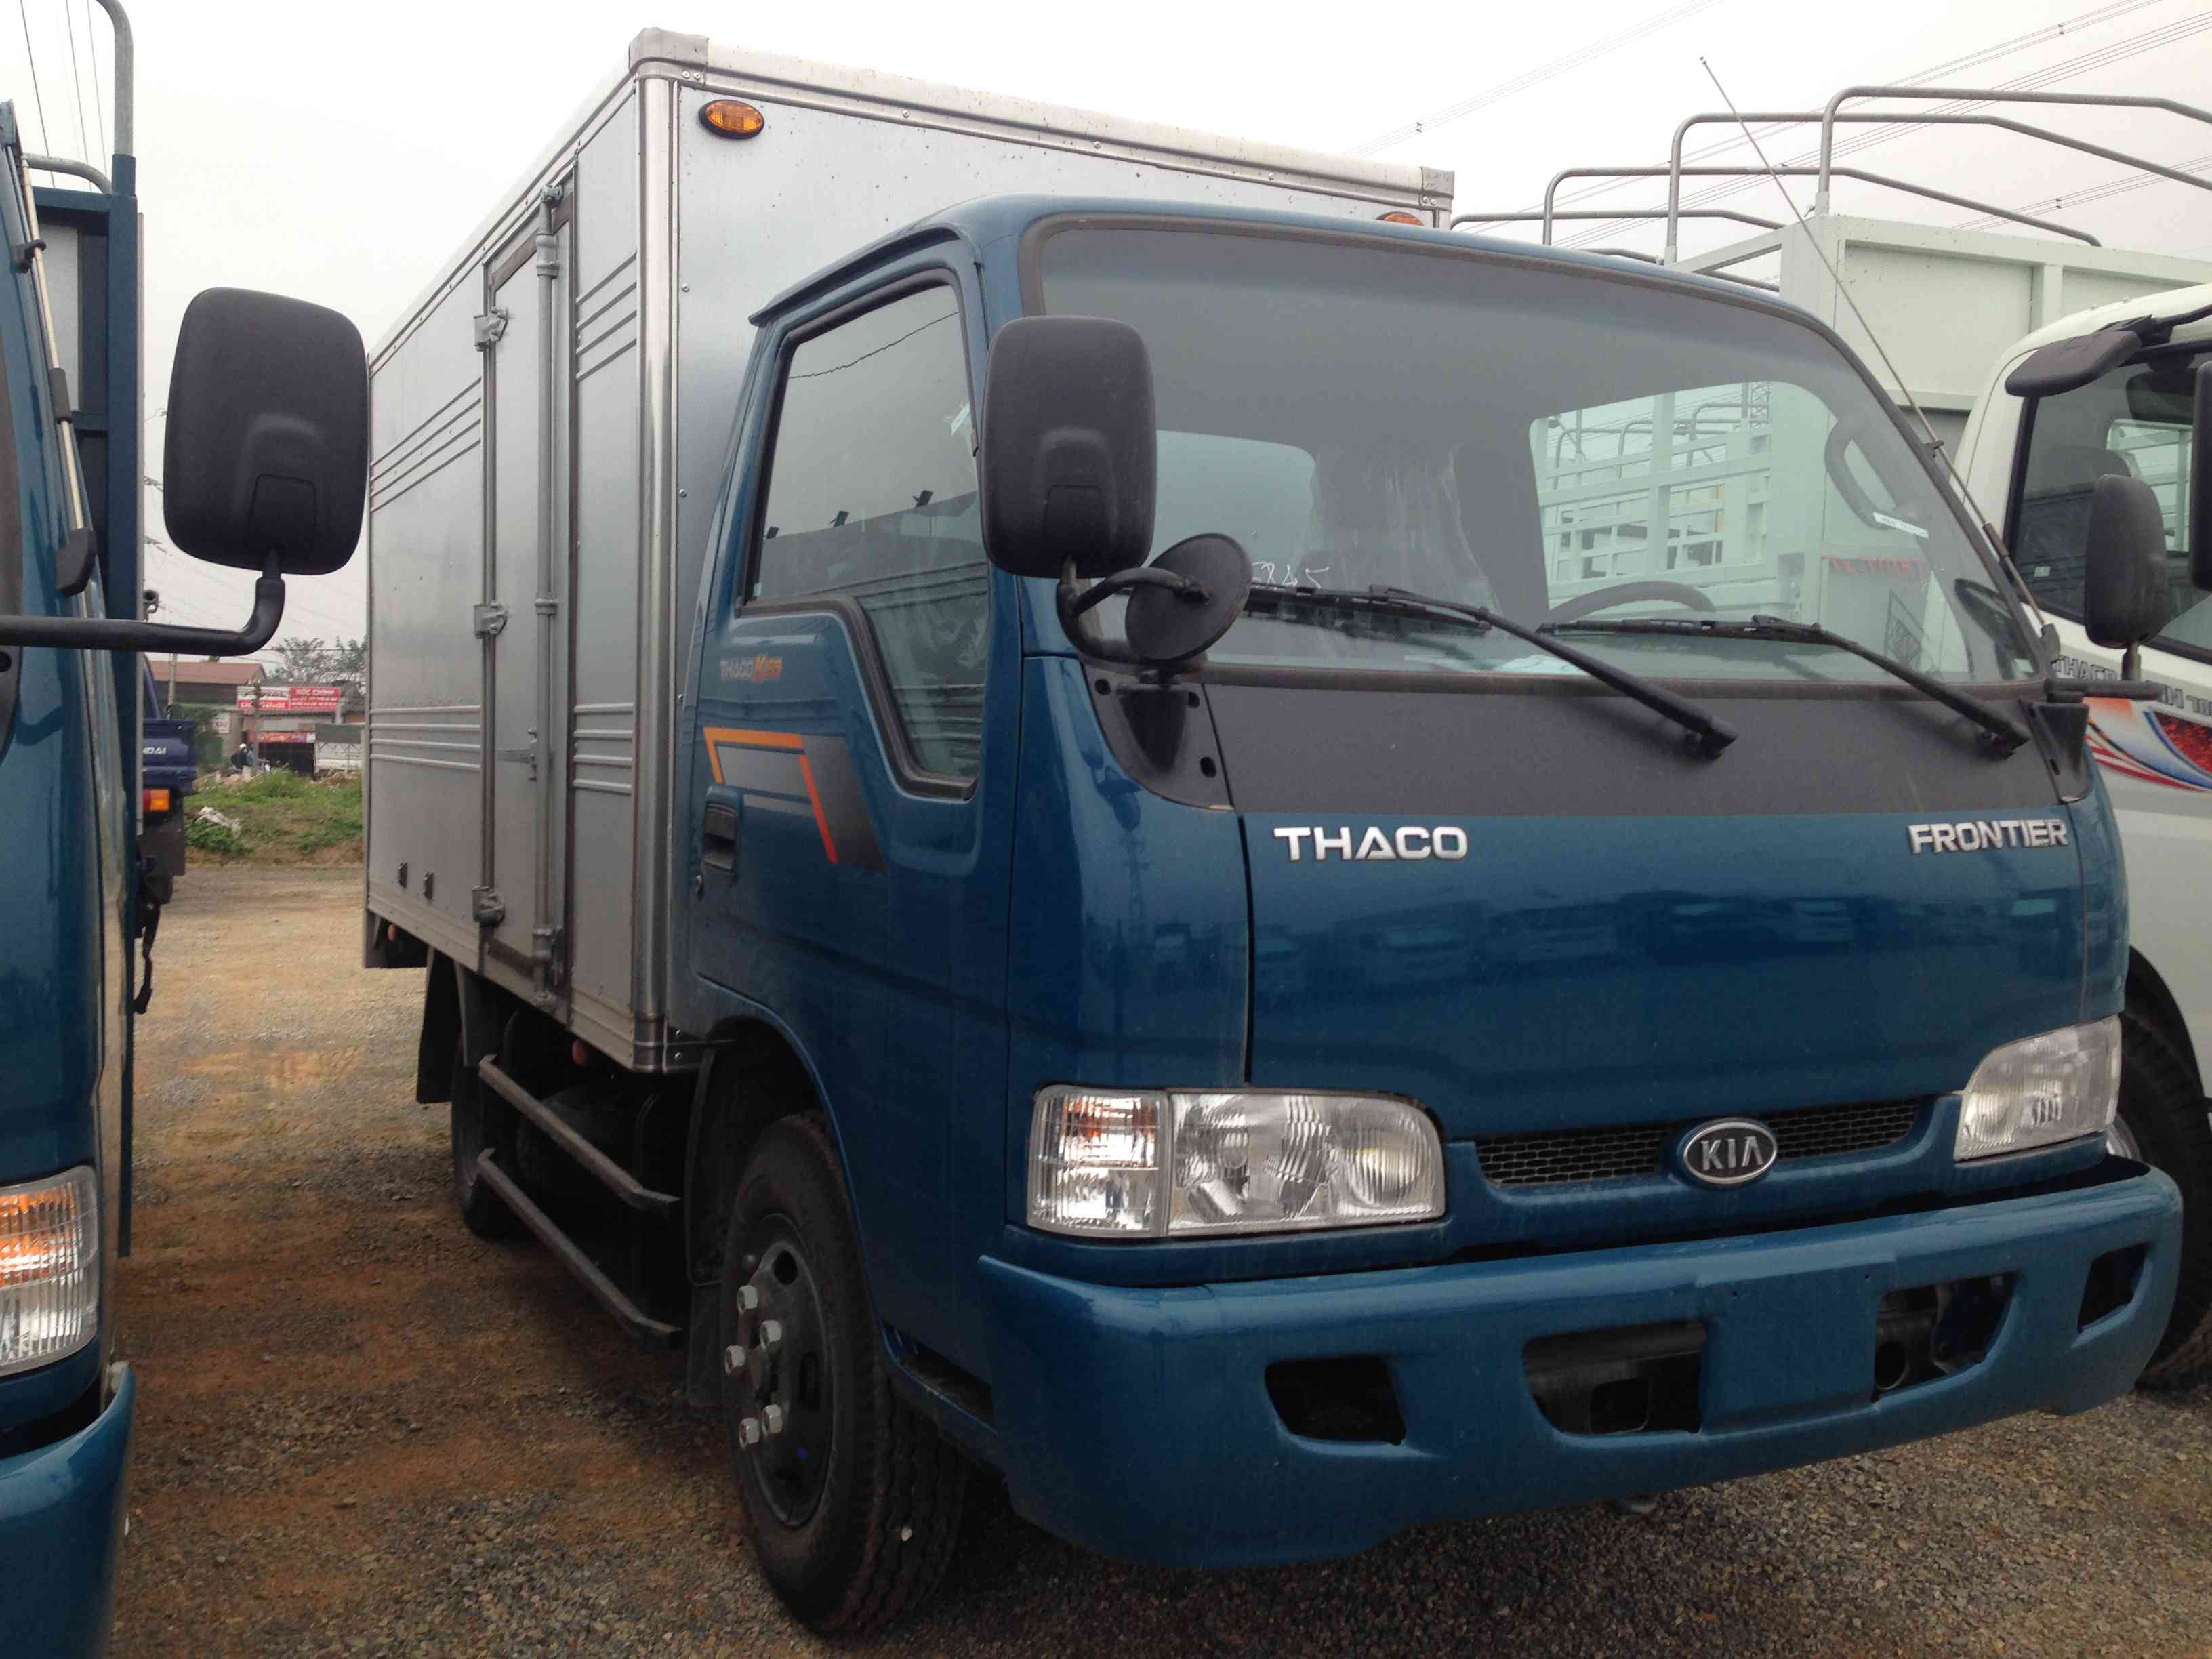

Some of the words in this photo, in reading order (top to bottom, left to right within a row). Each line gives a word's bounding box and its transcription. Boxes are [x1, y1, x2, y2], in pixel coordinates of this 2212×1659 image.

[1273, 825, 1468, 861] THACO
[1908, 819, 2068, 854] FRONTIER
[1700, 1136, 1763, 1171] KIA
